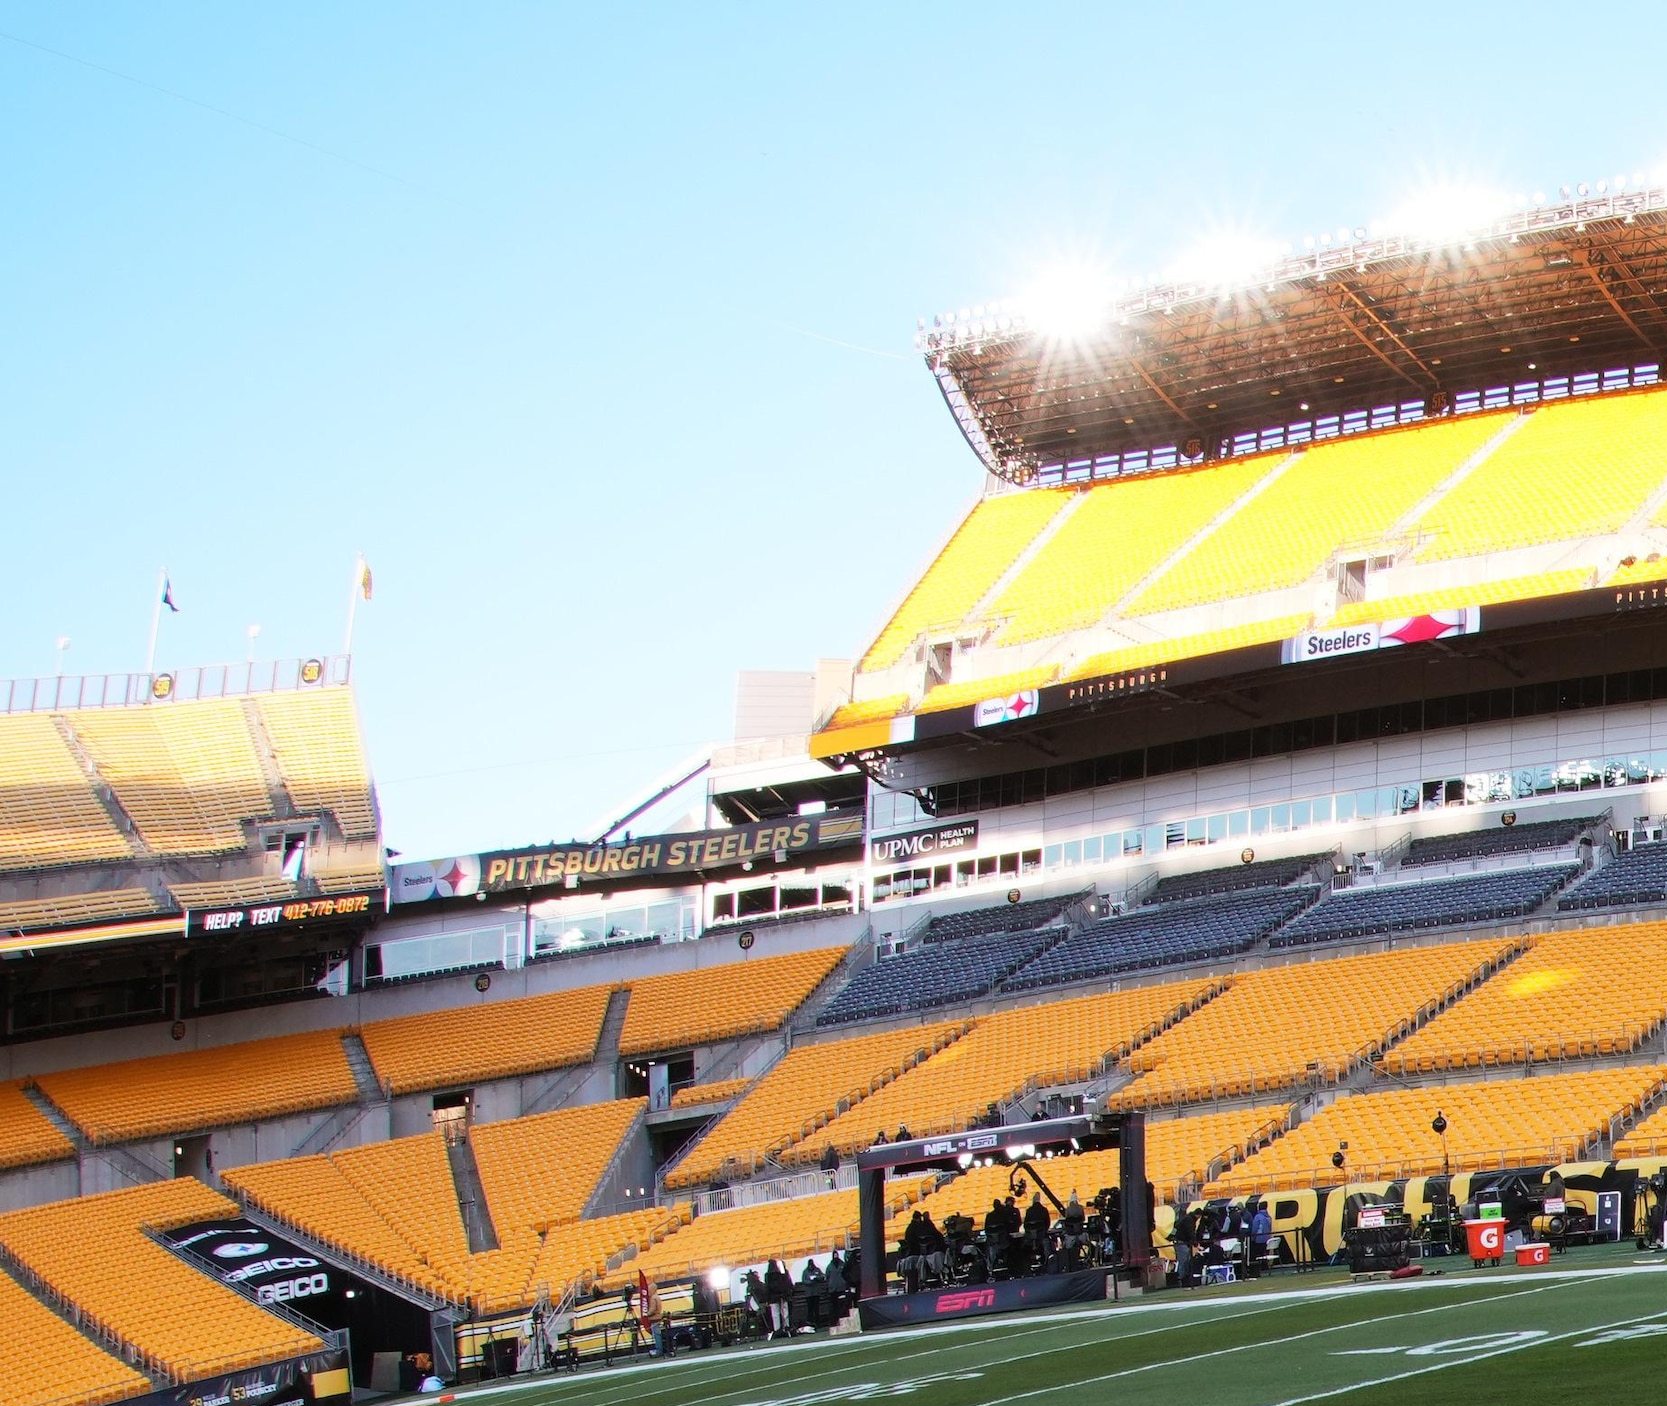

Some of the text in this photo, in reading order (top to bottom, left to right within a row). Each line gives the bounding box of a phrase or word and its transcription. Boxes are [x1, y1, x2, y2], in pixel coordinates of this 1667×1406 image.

[1308, 631, 1371, 655] Steelers
[1069, 671, 1166, 700] PITTSBURGH
[940, 826, 974, 840] HEALTH
[940, 837, 964, 849] PLAN
[487, 822, 811, 885] PITTSBURGH STEELERS
[874, 834, 934, 861] UPMC
[404, 875, 433, 887] Steelers
[204, 896, 369, 930] HELP? TEXT 412-776-0872
[924, 1141, 958, 1157] NFL
[1480, 1227, 1499, 1249] G
[1534, 1250, 1544, 1262] G
[259, 1273, 328, 1305] GEICO
[936, 1289, 996, 1313] ESPN
[232, 1386, 246, 1401] 53
[246, 1383, 278, 1398] POUNCEY
